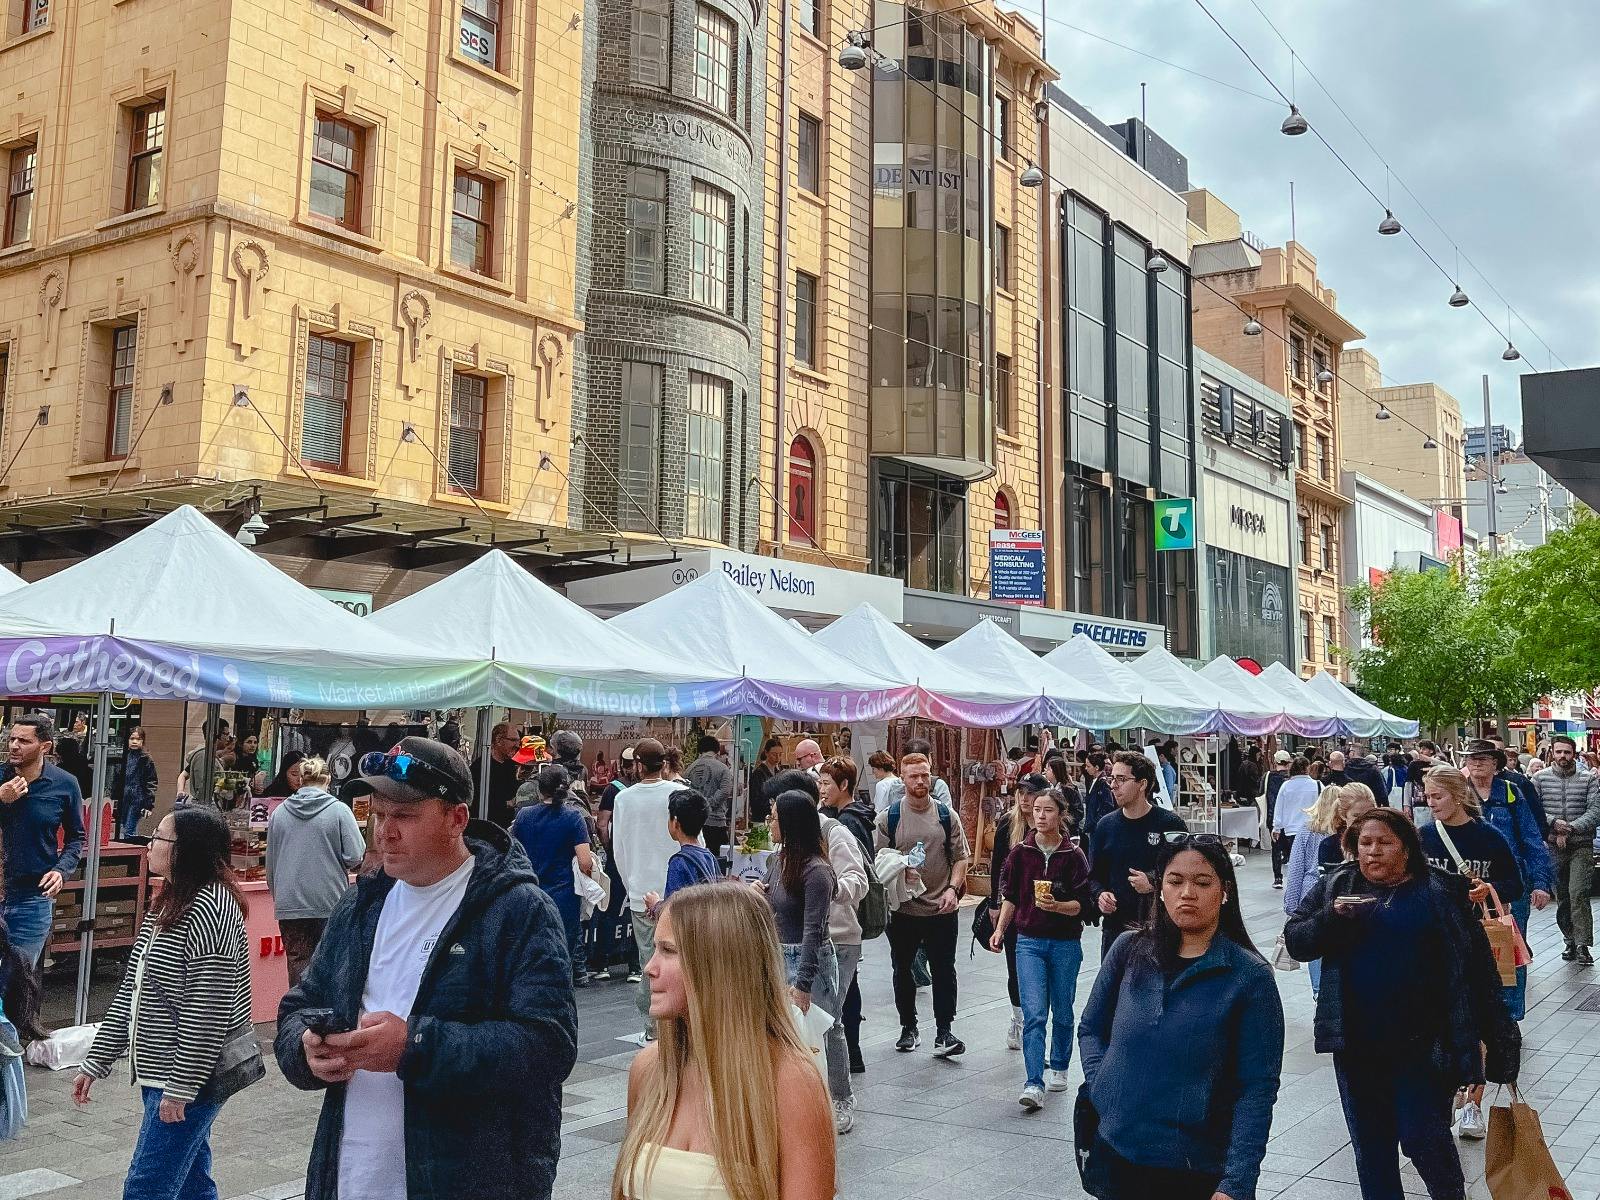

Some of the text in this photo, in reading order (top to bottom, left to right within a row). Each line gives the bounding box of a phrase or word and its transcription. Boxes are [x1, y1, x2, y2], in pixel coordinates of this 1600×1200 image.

[460, 27, 489, 56] SES
[663, 114, 722, 150] YOUNG
[876, 167, 961, 191] DENTIST
[1230, 504, 1266, 534] MECCA
[1009, 531, 1041, 539] McGEES
[722, 560, 816, 596] Bailey Nelson
[1072, 622, 1148, 647] SKECHERS
[5, 638, 203, 700] Gathered
[318, 680, 382, 704] Market
[387, 680, 405, 703] in
[407, 679, 435, 700] the
[442, 671, 471, 698] Mall
[554, 676, 661, 717] Gathered
[721, 687, 758, 706] Market
